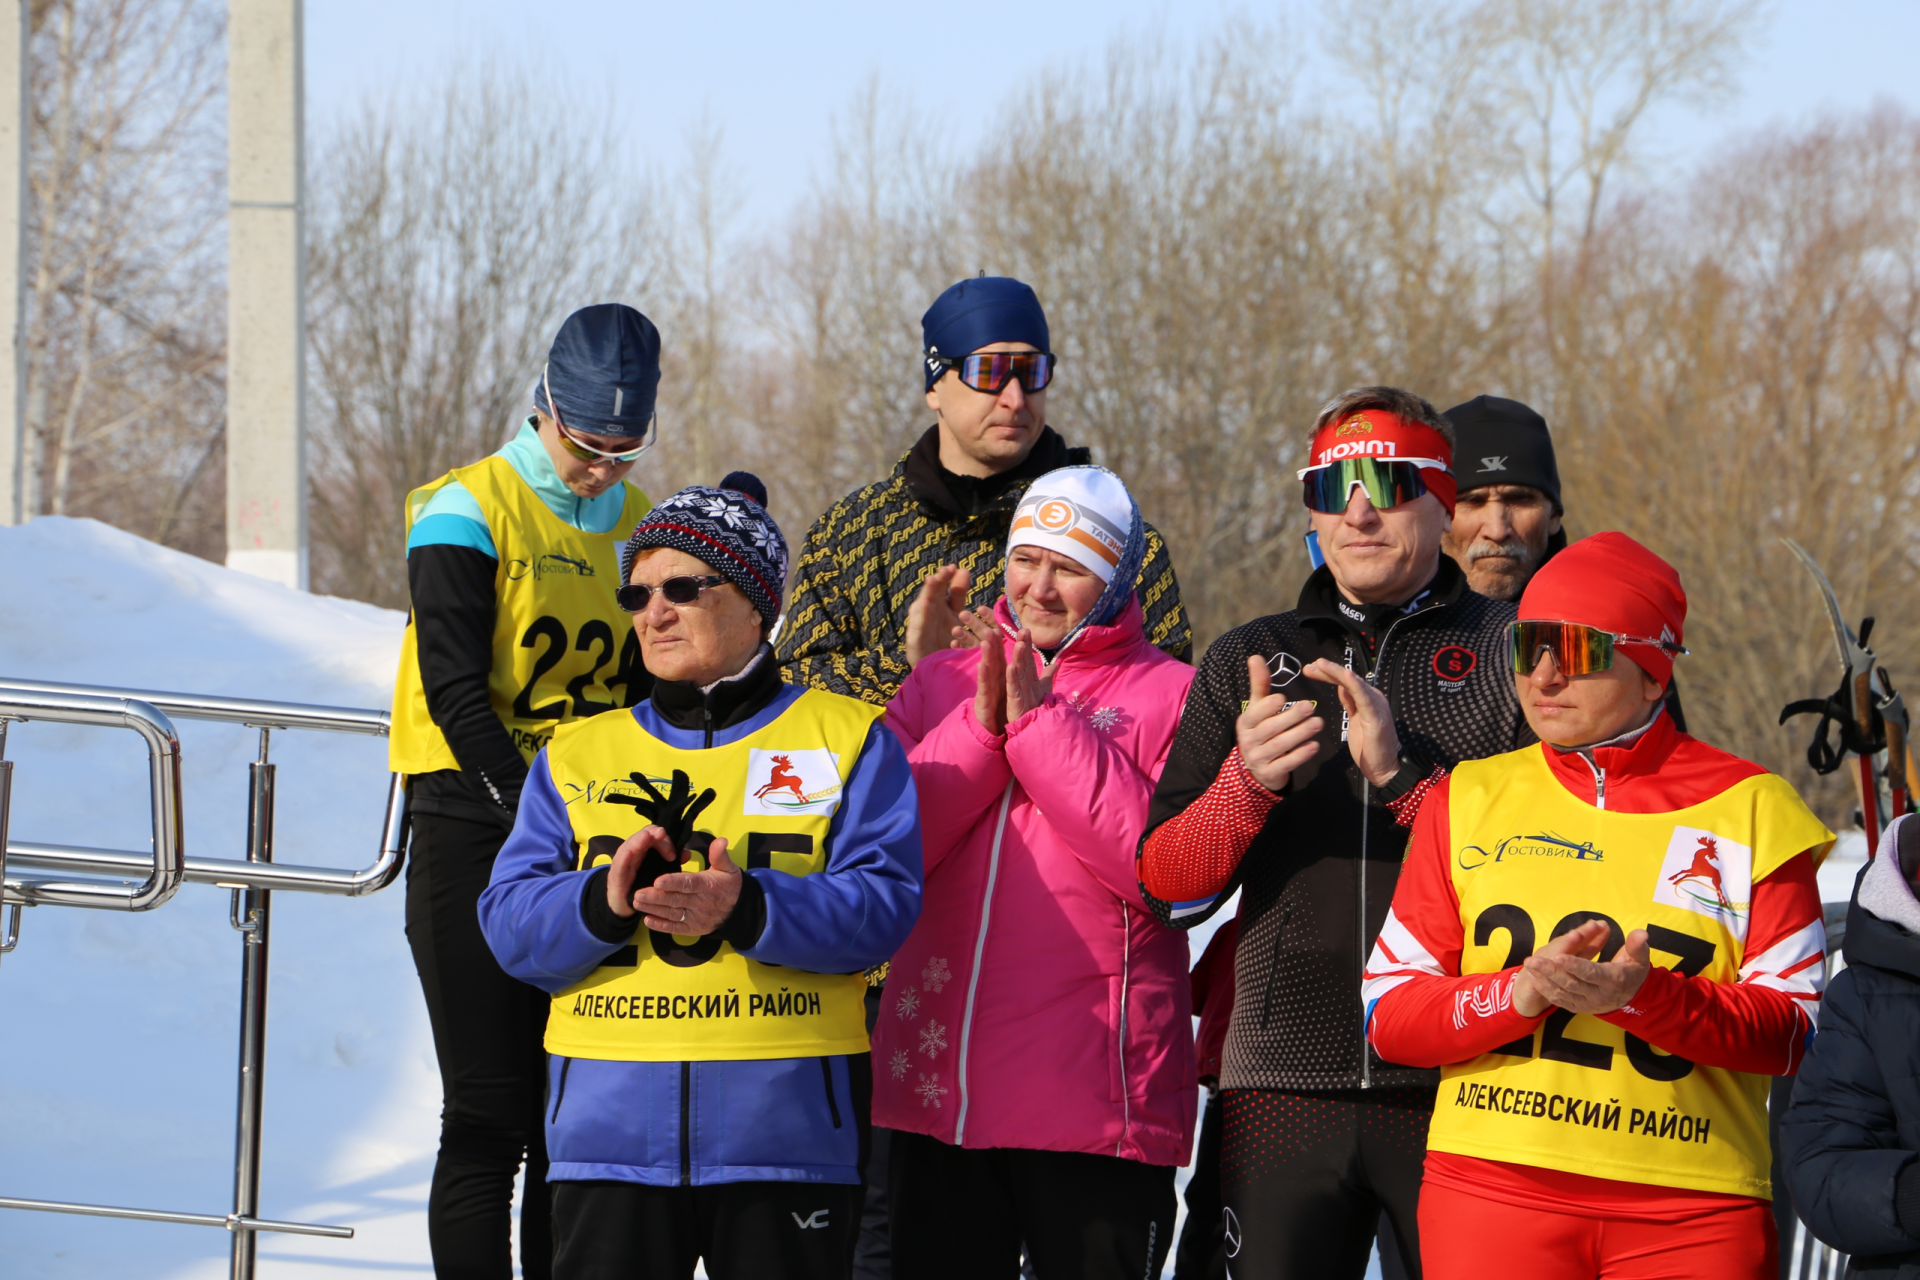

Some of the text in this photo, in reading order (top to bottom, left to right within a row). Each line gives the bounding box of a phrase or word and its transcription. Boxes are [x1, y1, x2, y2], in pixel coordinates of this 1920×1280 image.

[1318, 440, 1396, 465] LUKOIL
[1437, 680, 1466, 688] MASTERS
[573, 987, 822, 1019] АЛЕКСЕЕВСКИЙ РАЙОН
[1455, 1082, 1711, 1144] АЛЕКСЕЕВСКИЙ РАЙОН
